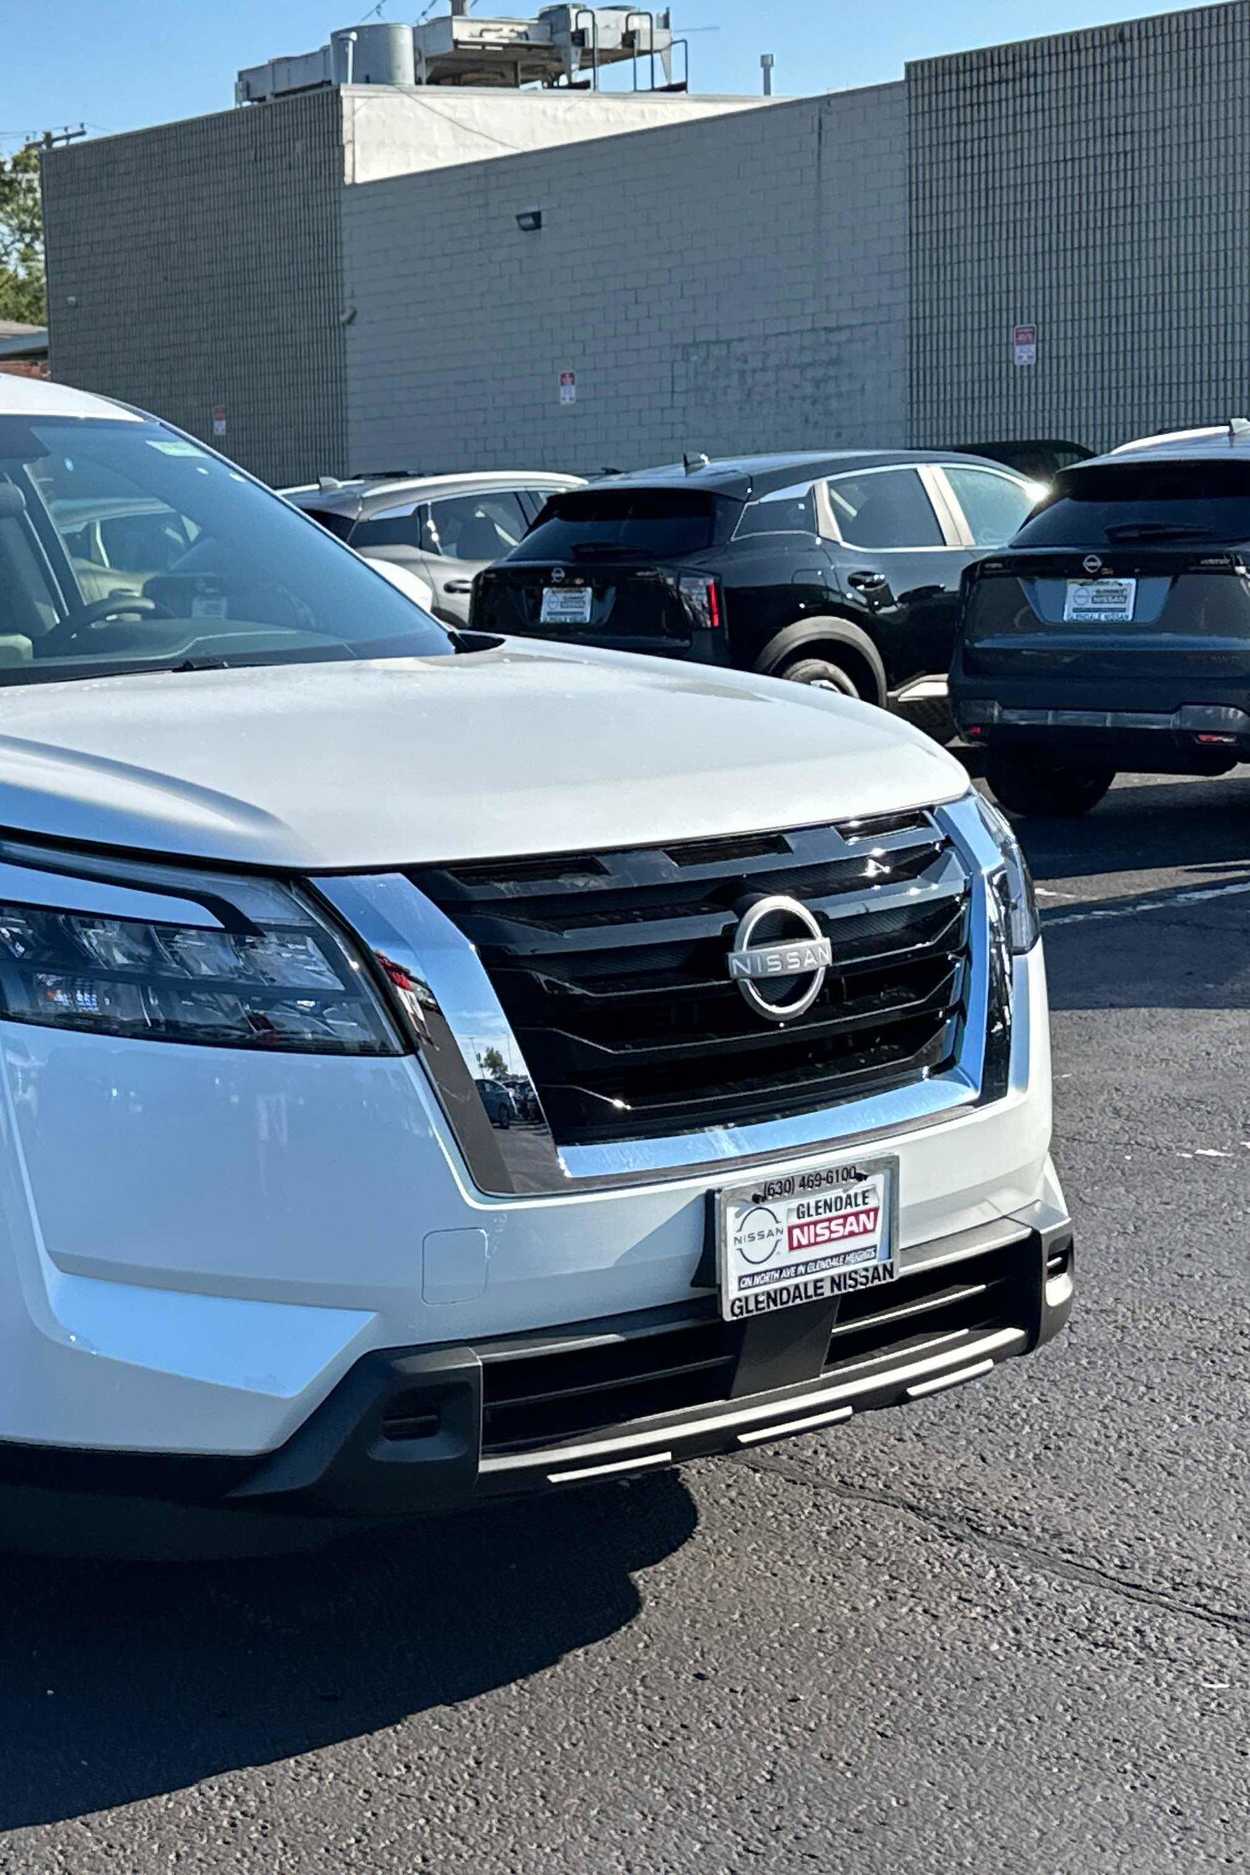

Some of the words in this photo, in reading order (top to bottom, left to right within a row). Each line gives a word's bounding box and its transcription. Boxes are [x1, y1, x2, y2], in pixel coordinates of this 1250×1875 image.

[732, 946, 830, 976] NISSAN
[763, 1177, 795, 1198] (630)
[799, 1166, 857, 1190] 469-6100
[796, 1189, 870, 1220] GLENDALE
[734, 1227, 784, 1246] NISSAN
[792, 1211, 875, 1247] NISSAN
[740, 1276, 754, 1288] ON
[753, 1271, 781, 1285] NORTH
[780, 1267, 796, 1280] AVE
[796, 1264, 806, 1276] IN
[806, 1255, 844, 1274] GLENDALE
[730, 1278, 825, 1318] GLENDALE
[830, 1261, 894, 1293] NISSAN
